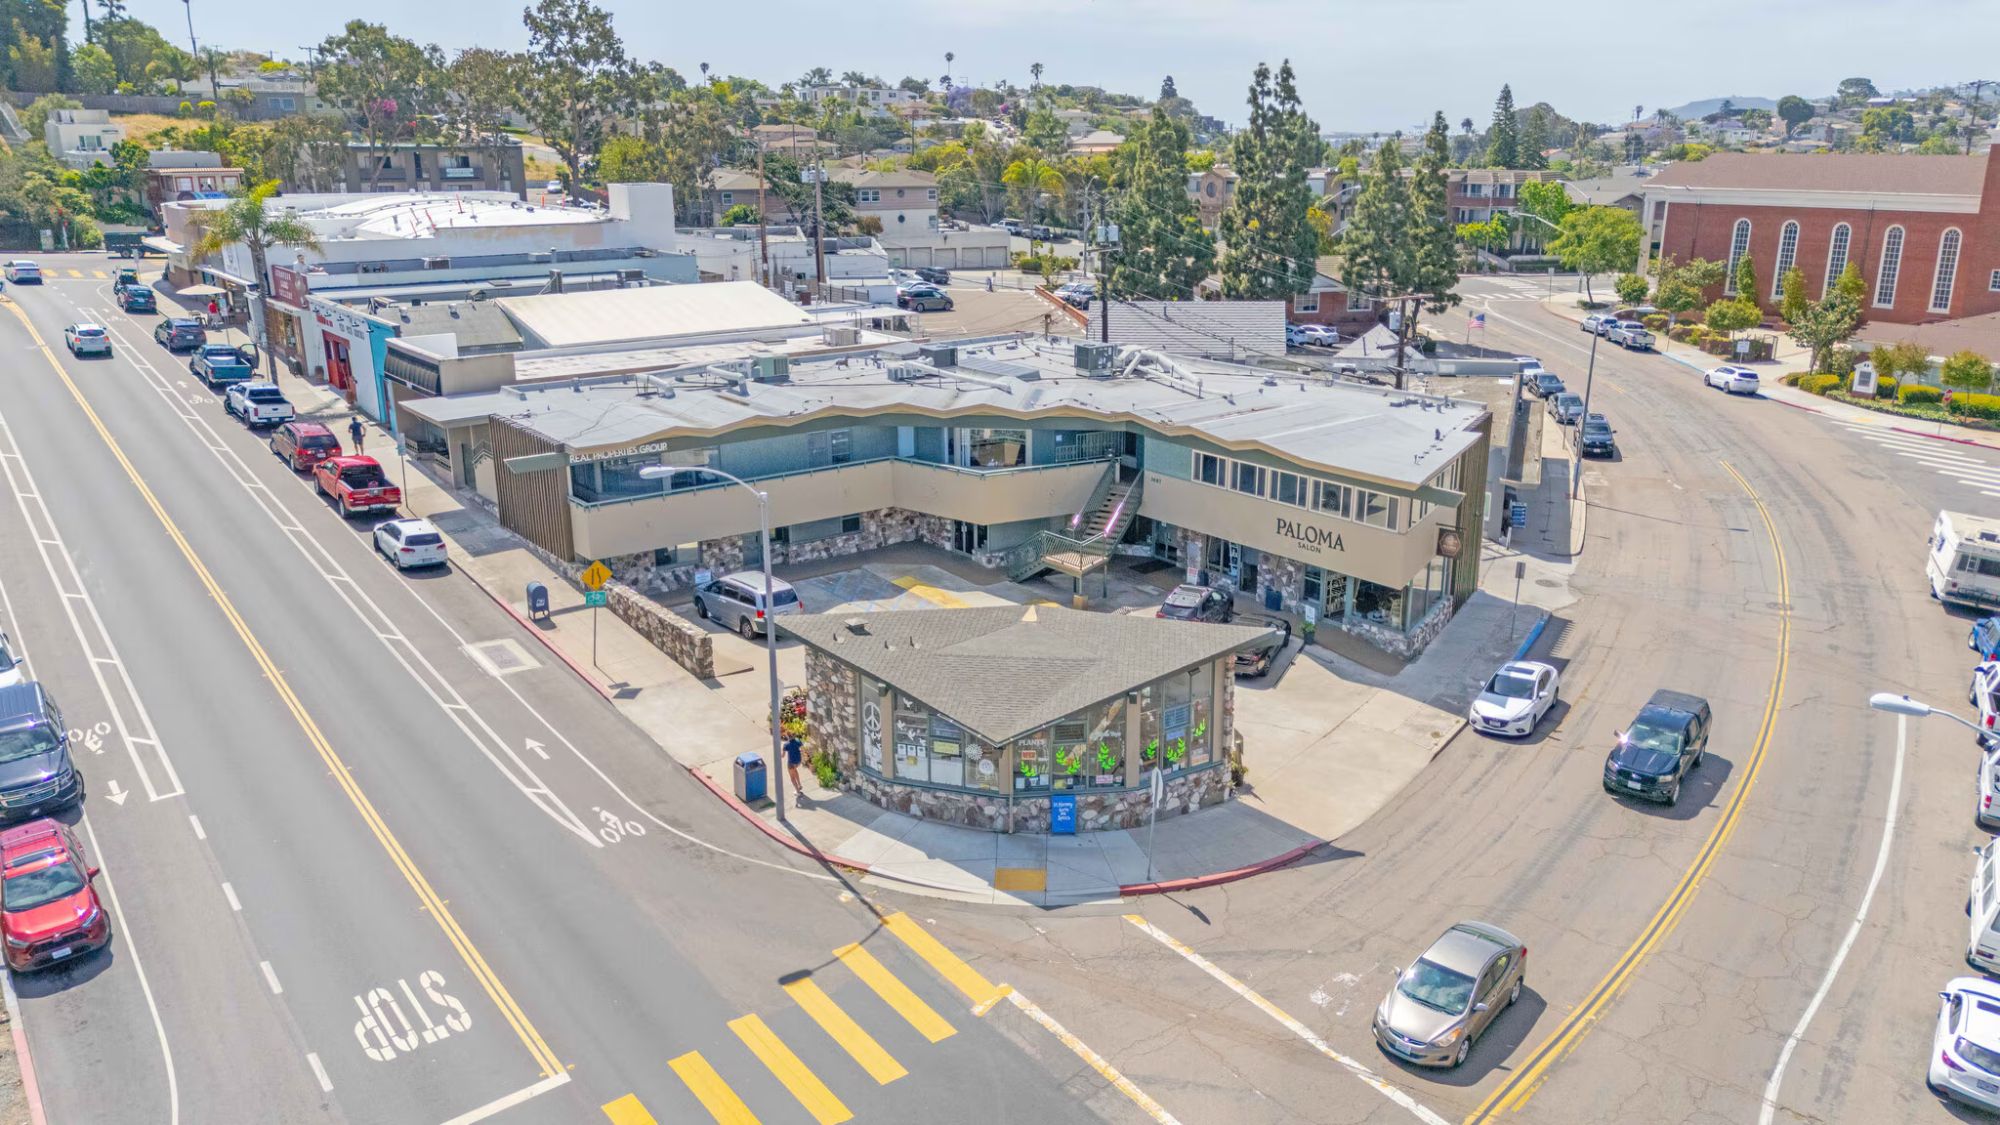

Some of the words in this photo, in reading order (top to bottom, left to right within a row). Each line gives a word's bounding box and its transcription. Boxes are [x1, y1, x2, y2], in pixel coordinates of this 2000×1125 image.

[569, 454, 592, 464] REAL
[593, 446, 637, 460] PROPERTIES
[639, 442, 668, 454] GROUP
[1276, 518, 1345, 552] PALOMA
[1297, 542, 1321, 553] SALON
[354, 970, 472, 1061] STOP
